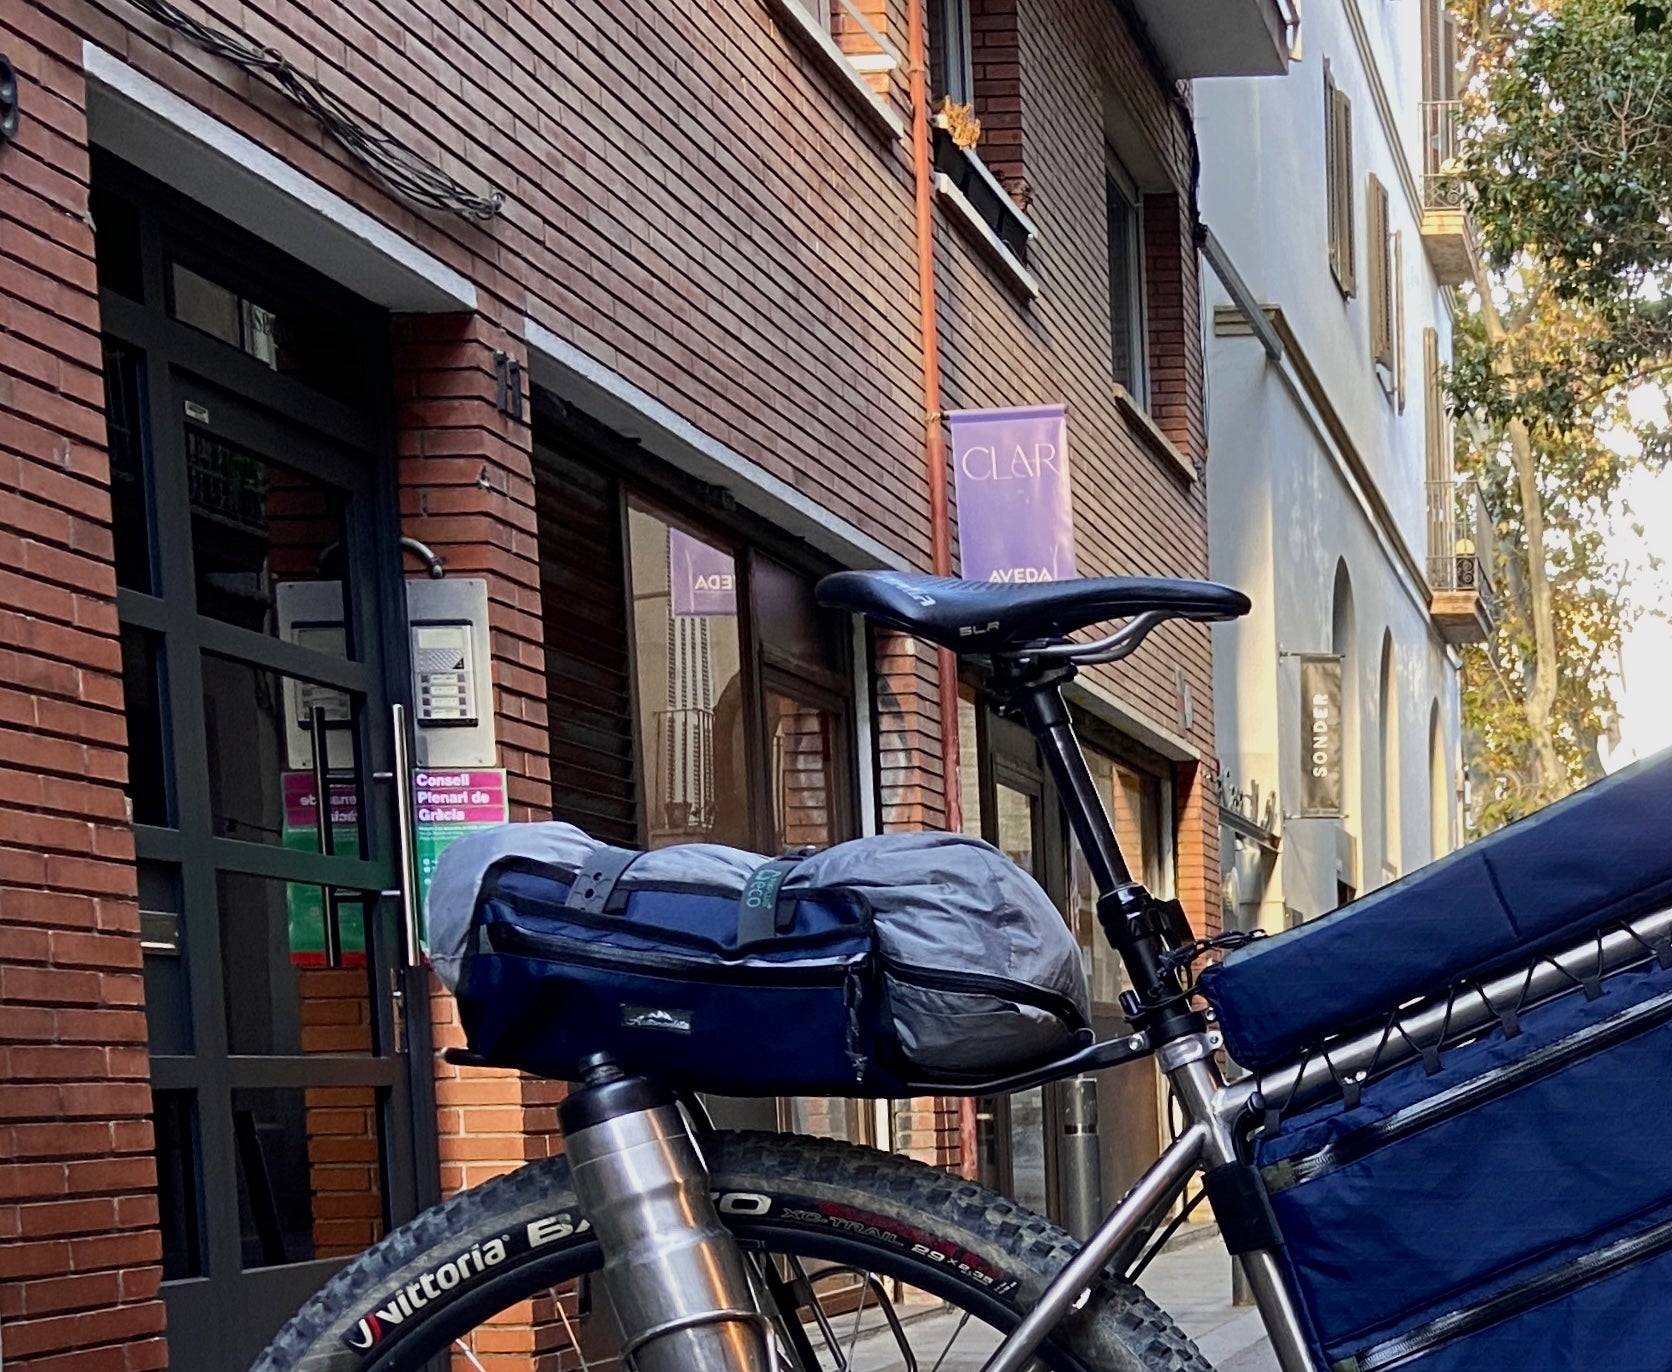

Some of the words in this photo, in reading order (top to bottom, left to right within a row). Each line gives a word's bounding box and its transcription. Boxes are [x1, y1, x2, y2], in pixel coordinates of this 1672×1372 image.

[962, 443, 1060, 481] CLAR
[988, 567, 1053, 593] AVEDA
[959, 621, 1000, 637] SLR
[1312, 693, 1329, 777] SONDER
[416, 773, 470, 787] Consell
[417, 790, 469, 804] Plenari
[471, 791, 491, 804] de
[418, 808, 466, 822] Gràcia
[911, 1243, 945, 1263] 29
[376, 1238, 507, 1324] vittoria
